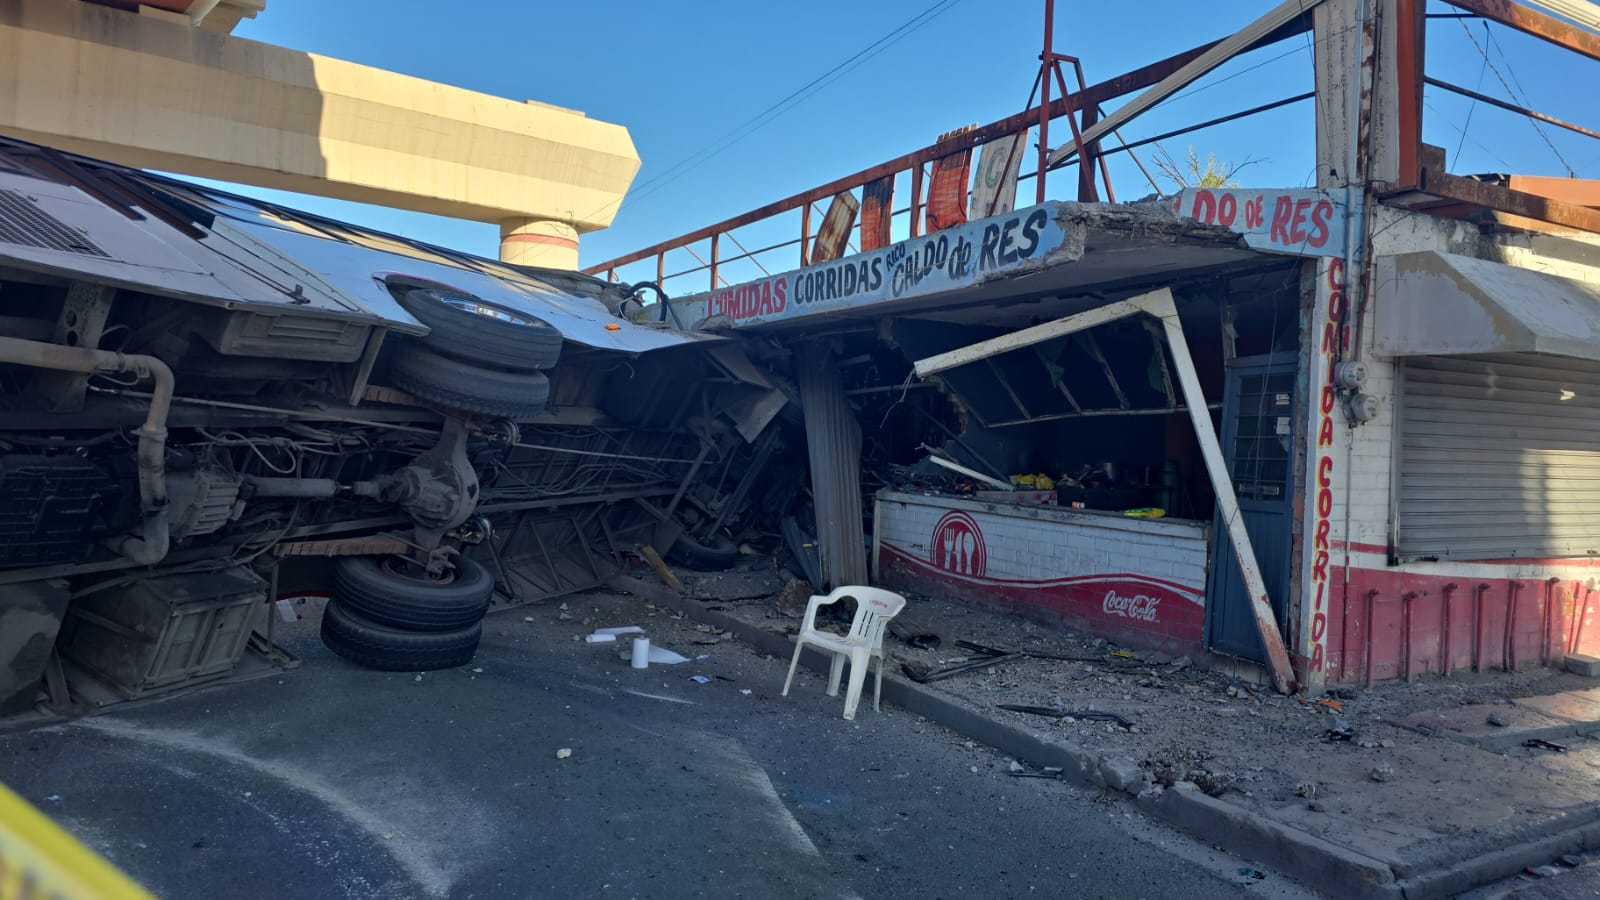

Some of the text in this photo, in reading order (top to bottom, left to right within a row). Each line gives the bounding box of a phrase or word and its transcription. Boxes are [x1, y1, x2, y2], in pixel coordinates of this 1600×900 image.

[979, 208, 1048, 271] RES
[1173, 189, 1334, 248] DO DE RES
[794, 257, 882, 305] CORRIDAS
[886, 243, 906, 272] RICO
[891, 234, 948, 298] CALDO
[707, 277, 788, 320] COMIDAS
[1308, 455, 1333, 674] CORRIDA
[1103, 590, 1161, 622] Coca-Cola
